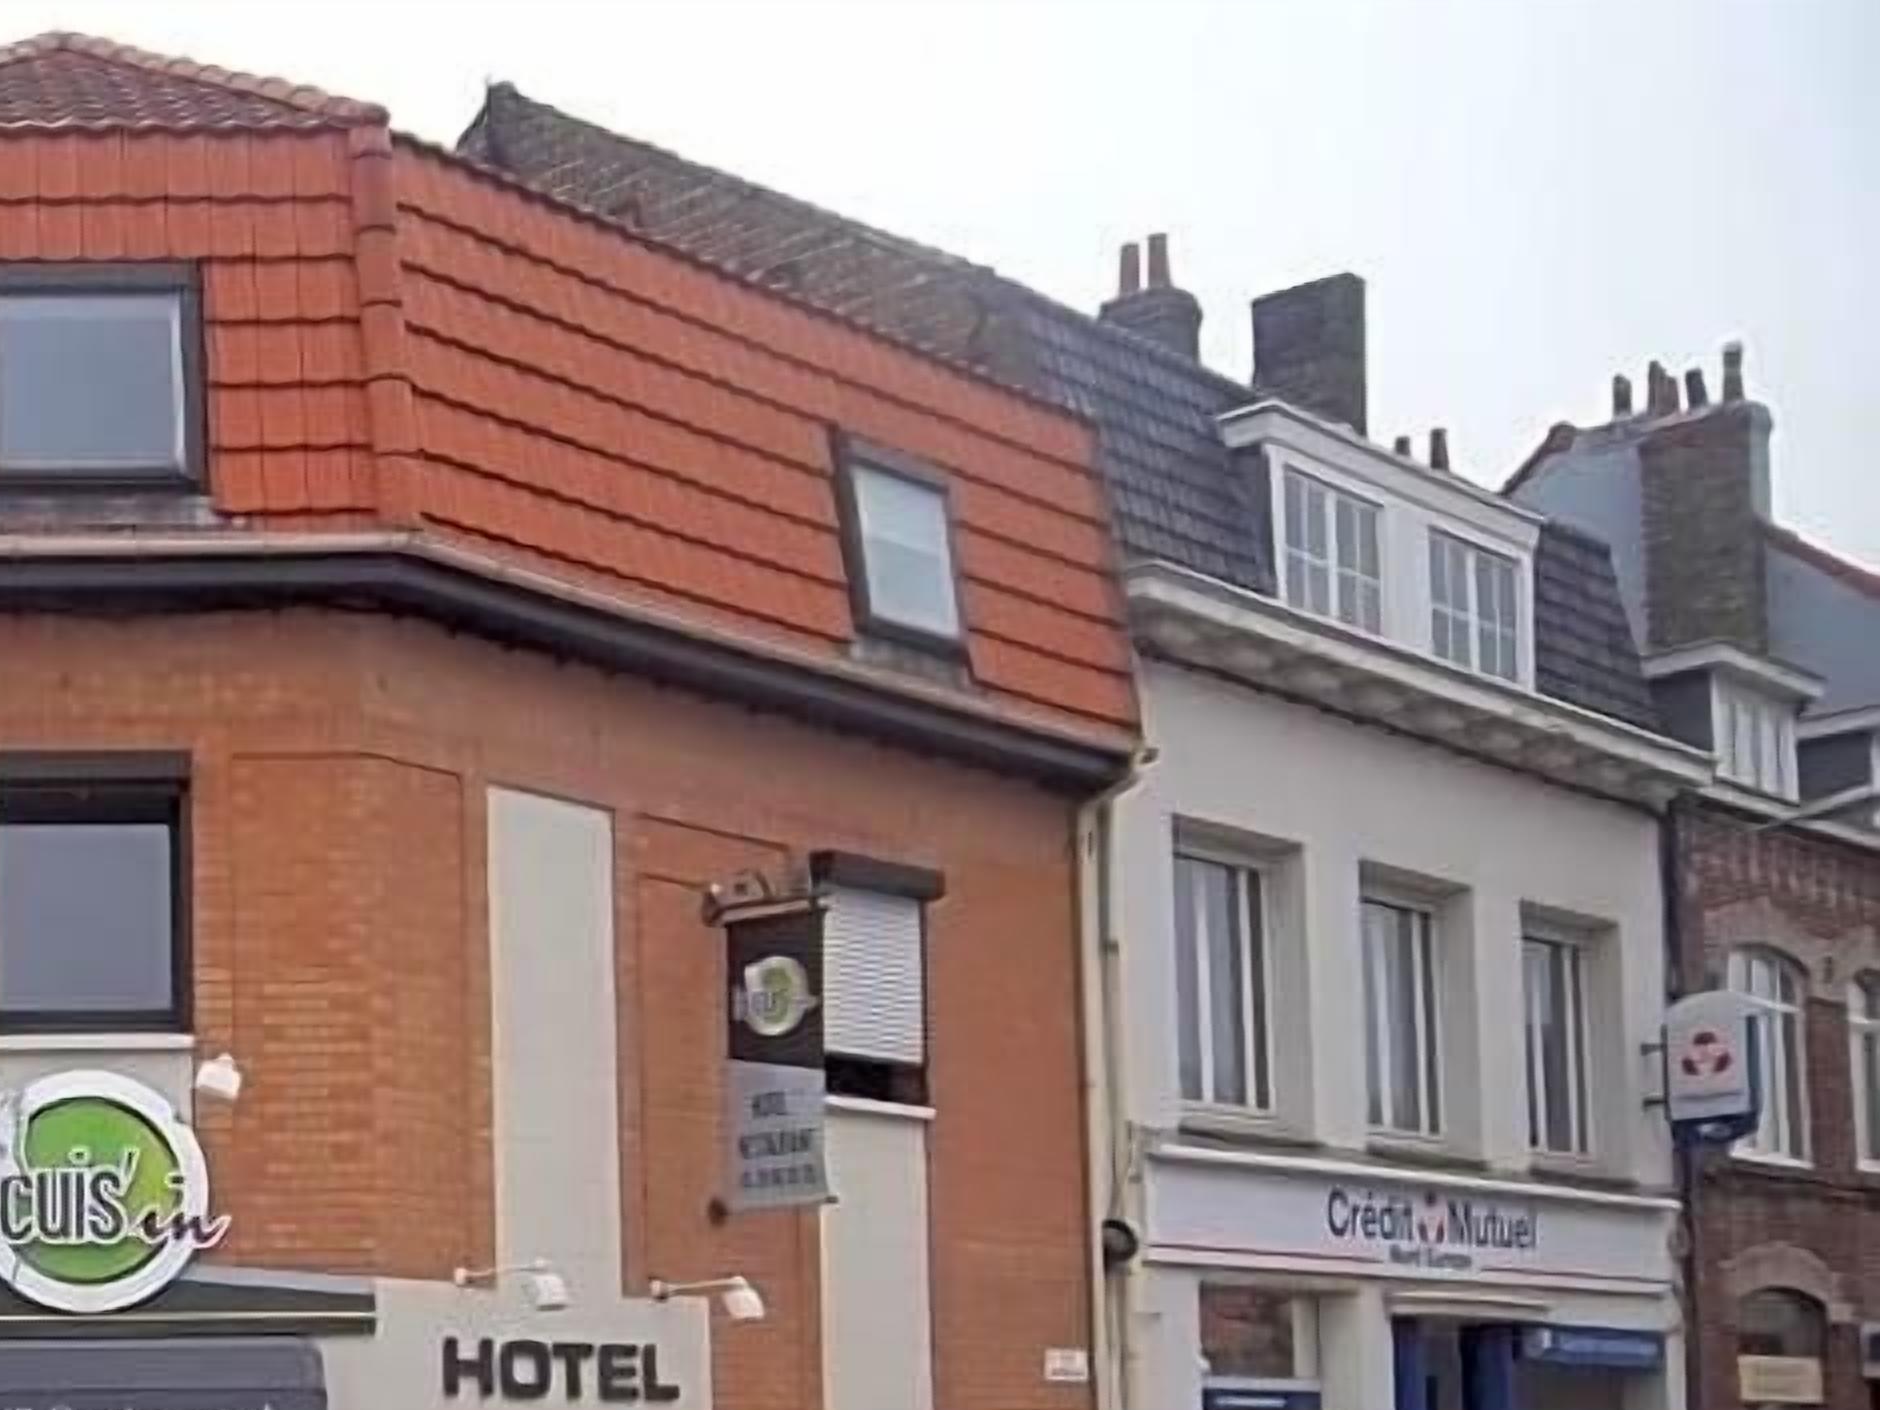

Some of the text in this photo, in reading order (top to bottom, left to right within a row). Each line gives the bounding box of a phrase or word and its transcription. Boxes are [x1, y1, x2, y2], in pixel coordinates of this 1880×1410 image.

[1327, 1187, 1538, 1249] Crédit Mutuel
[441, 1335, 681, 1402] HOTEL
